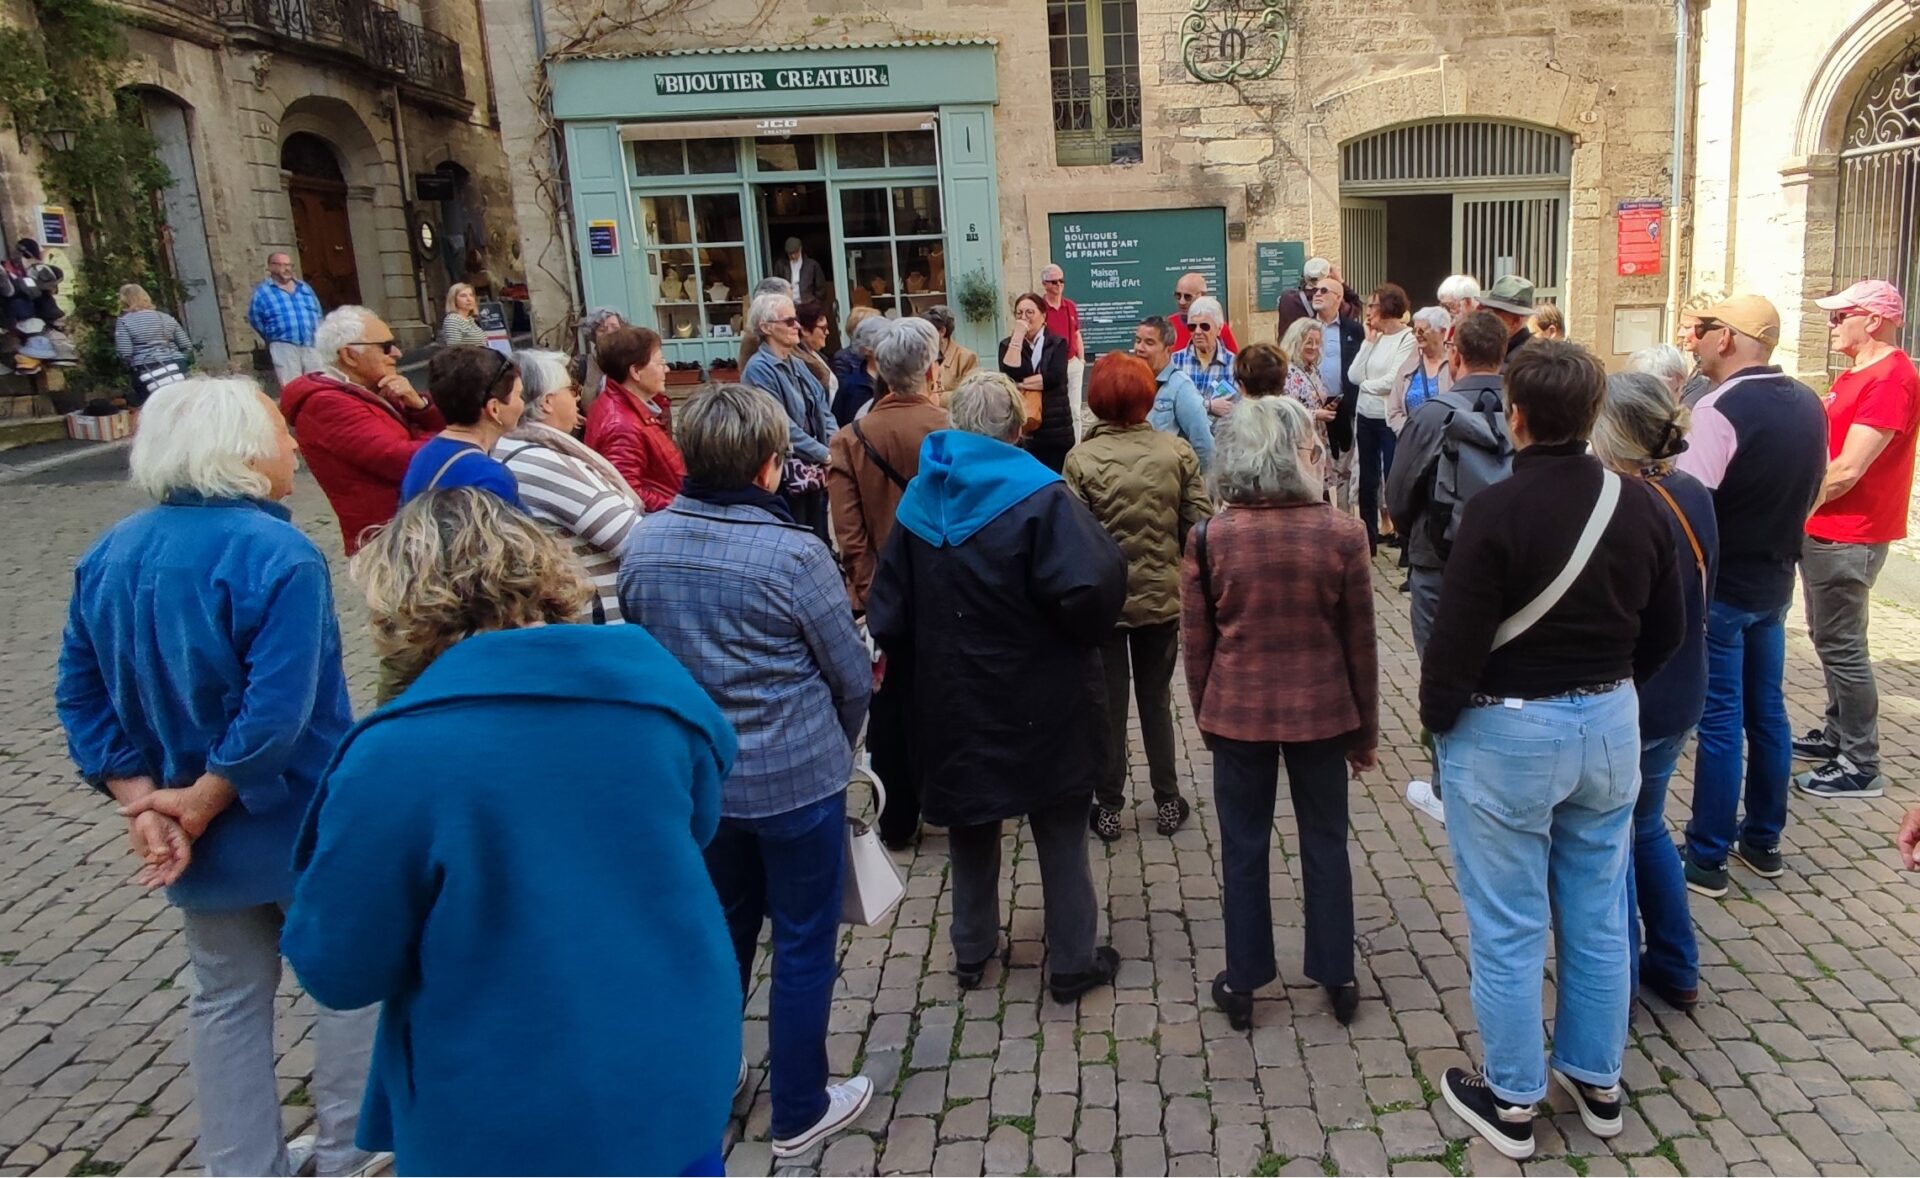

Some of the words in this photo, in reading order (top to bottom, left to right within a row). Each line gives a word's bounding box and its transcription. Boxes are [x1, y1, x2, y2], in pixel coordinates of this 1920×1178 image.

[664, 72, 766, 93] BIJOUTIER
[776, 67, 879, 88] CREATEUR
[756, 119, 798, 129] JCG
[969, 223, 975, 232] 6
[1064, 225, 1081, 233] LES
[966, 233, 978, 241] BIS
[1064, 232, 1118, 241] BOUTIQUES
[1065, 241, 1108, 250] ATELIERS
[1111, 240, 1139, 248] D'ART
[1081, 249, 1118, 258] FRANCE
[1090, 268, 1118, 277] Maison
[1091, 279, 1120, 288] Métiers
[1121, 278, 1141, 287] d'Art
